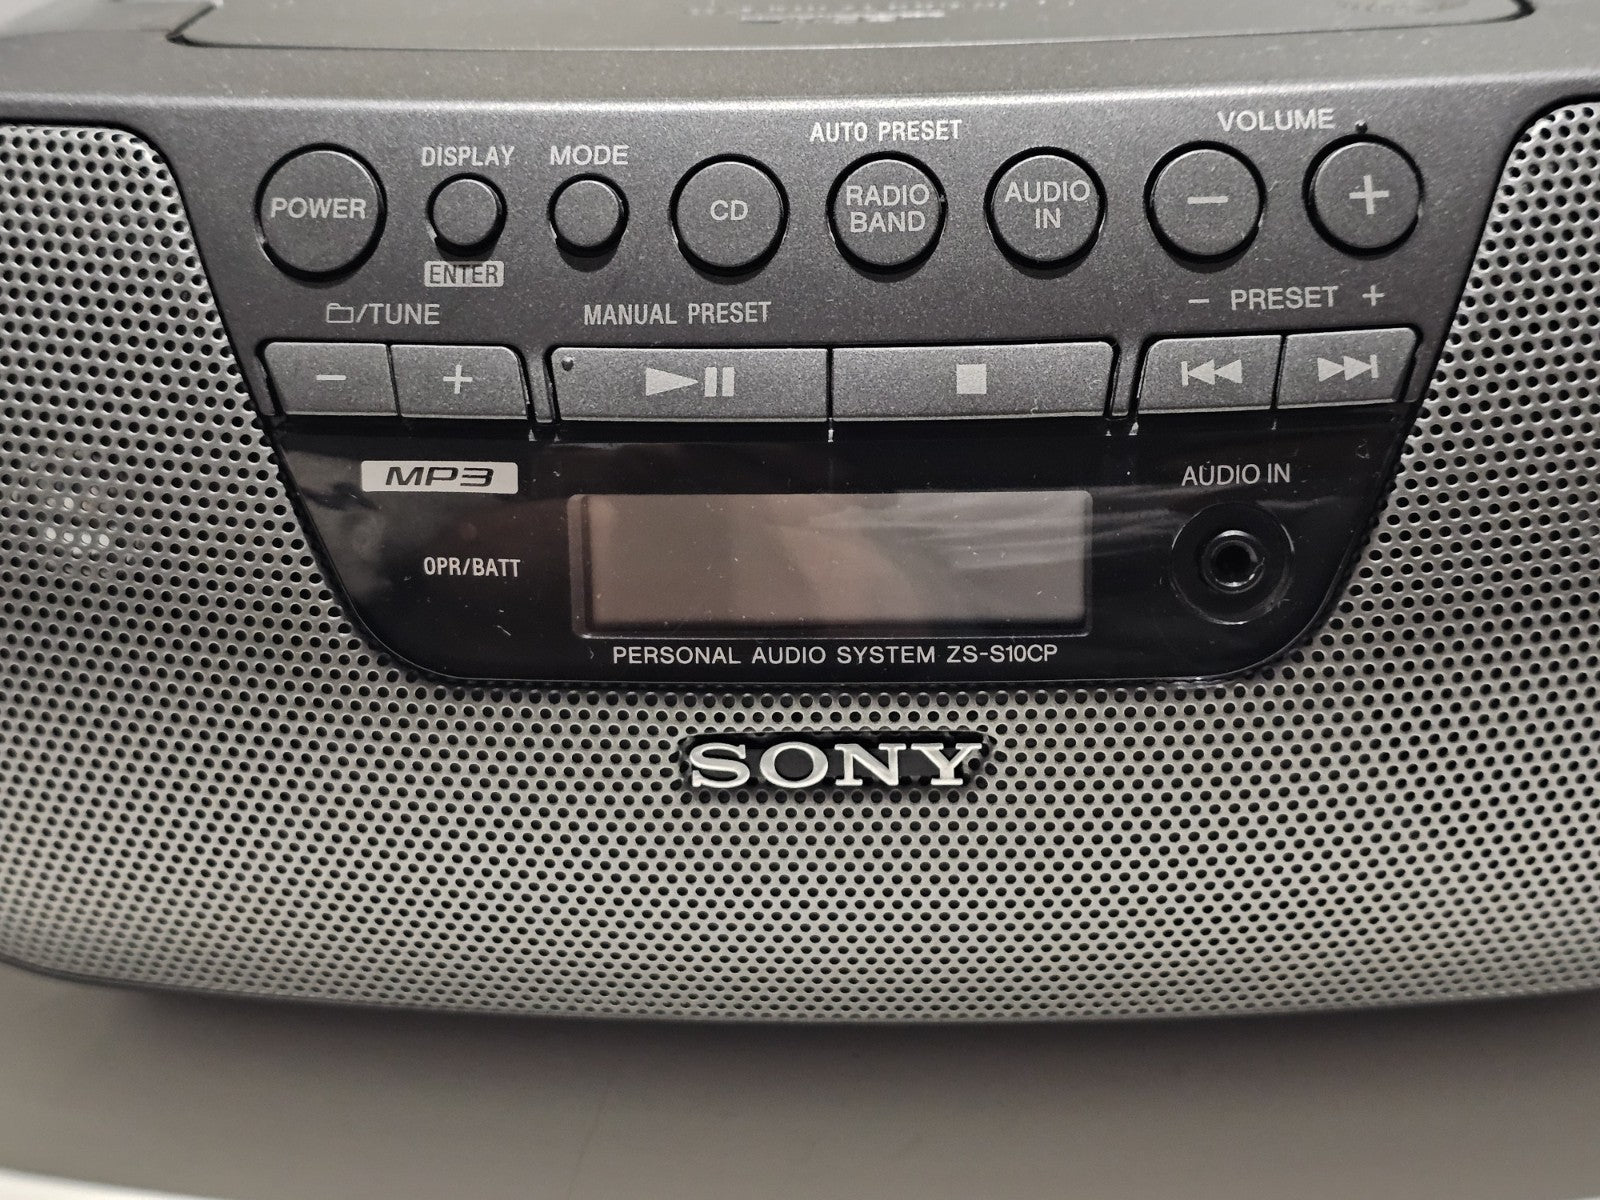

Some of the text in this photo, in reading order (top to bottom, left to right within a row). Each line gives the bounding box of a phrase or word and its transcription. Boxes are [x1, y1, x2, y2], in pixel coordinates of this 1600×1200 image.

[810, 119, 963, 143] AUTO PRESET
[1217, 108, 1335, 132] VOLUME
[421, 146, 515, 167] DISPLAY
[550, 145, 629, 166] MODE
[846, 184, 930, 206] RADIO
[1004, 180, 1091, 204] AUDIO
[270, 198, 367, 219] POWER
[710, 201, 748, 221] CD
[1035, 207, 1061, 229] IN
[850, 210, 926, 232] BAND
[429, 264, 499, 285] ENTER
[1231, 285, 1338, 310] PRESET
[584, 302, 771, 325] MANUAL PRESET
[385, 466, 494, 487] MP3
[1181, 463, 1291, 486] AUDIO IN
[423, 557, 520, 577] OPR/BATT
[612, 644, 1059, 664] PERSONAL AUDIO SYSTEM ZS-S10CP
[689, 742, 983, 788] SONY
